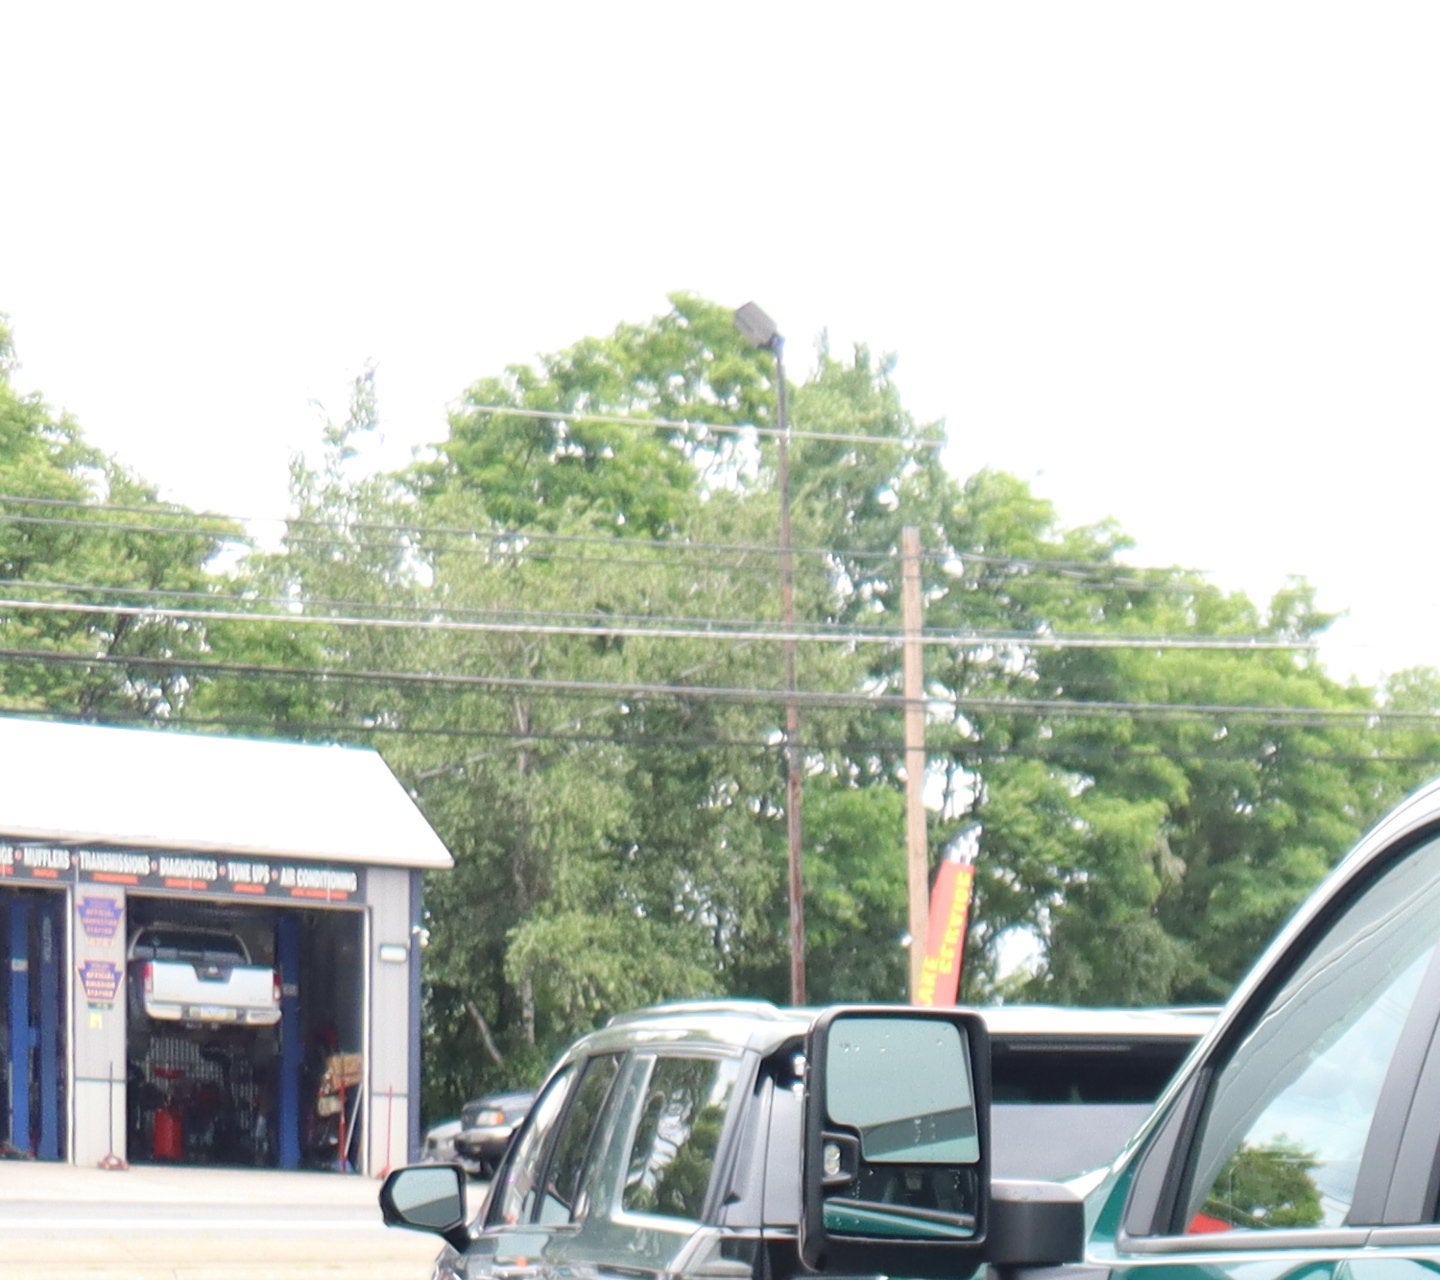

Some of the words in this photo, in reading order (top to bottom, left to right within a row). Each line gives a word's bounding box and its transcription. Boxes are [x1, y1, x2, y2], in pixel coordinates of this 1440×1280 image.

[23, 847, 71, 871] MUFFLERS
[79, 850, 150, 876] TRANSMISSIONS
[159, 856, 218, 882] DIAGNOSTICS
[227, 861, 251, 884] TUNE
[252, 863, 271, 885] UPS
[279, 866, 296, 888] AIR
[296, 867, 358, 893] CONDITIONING
